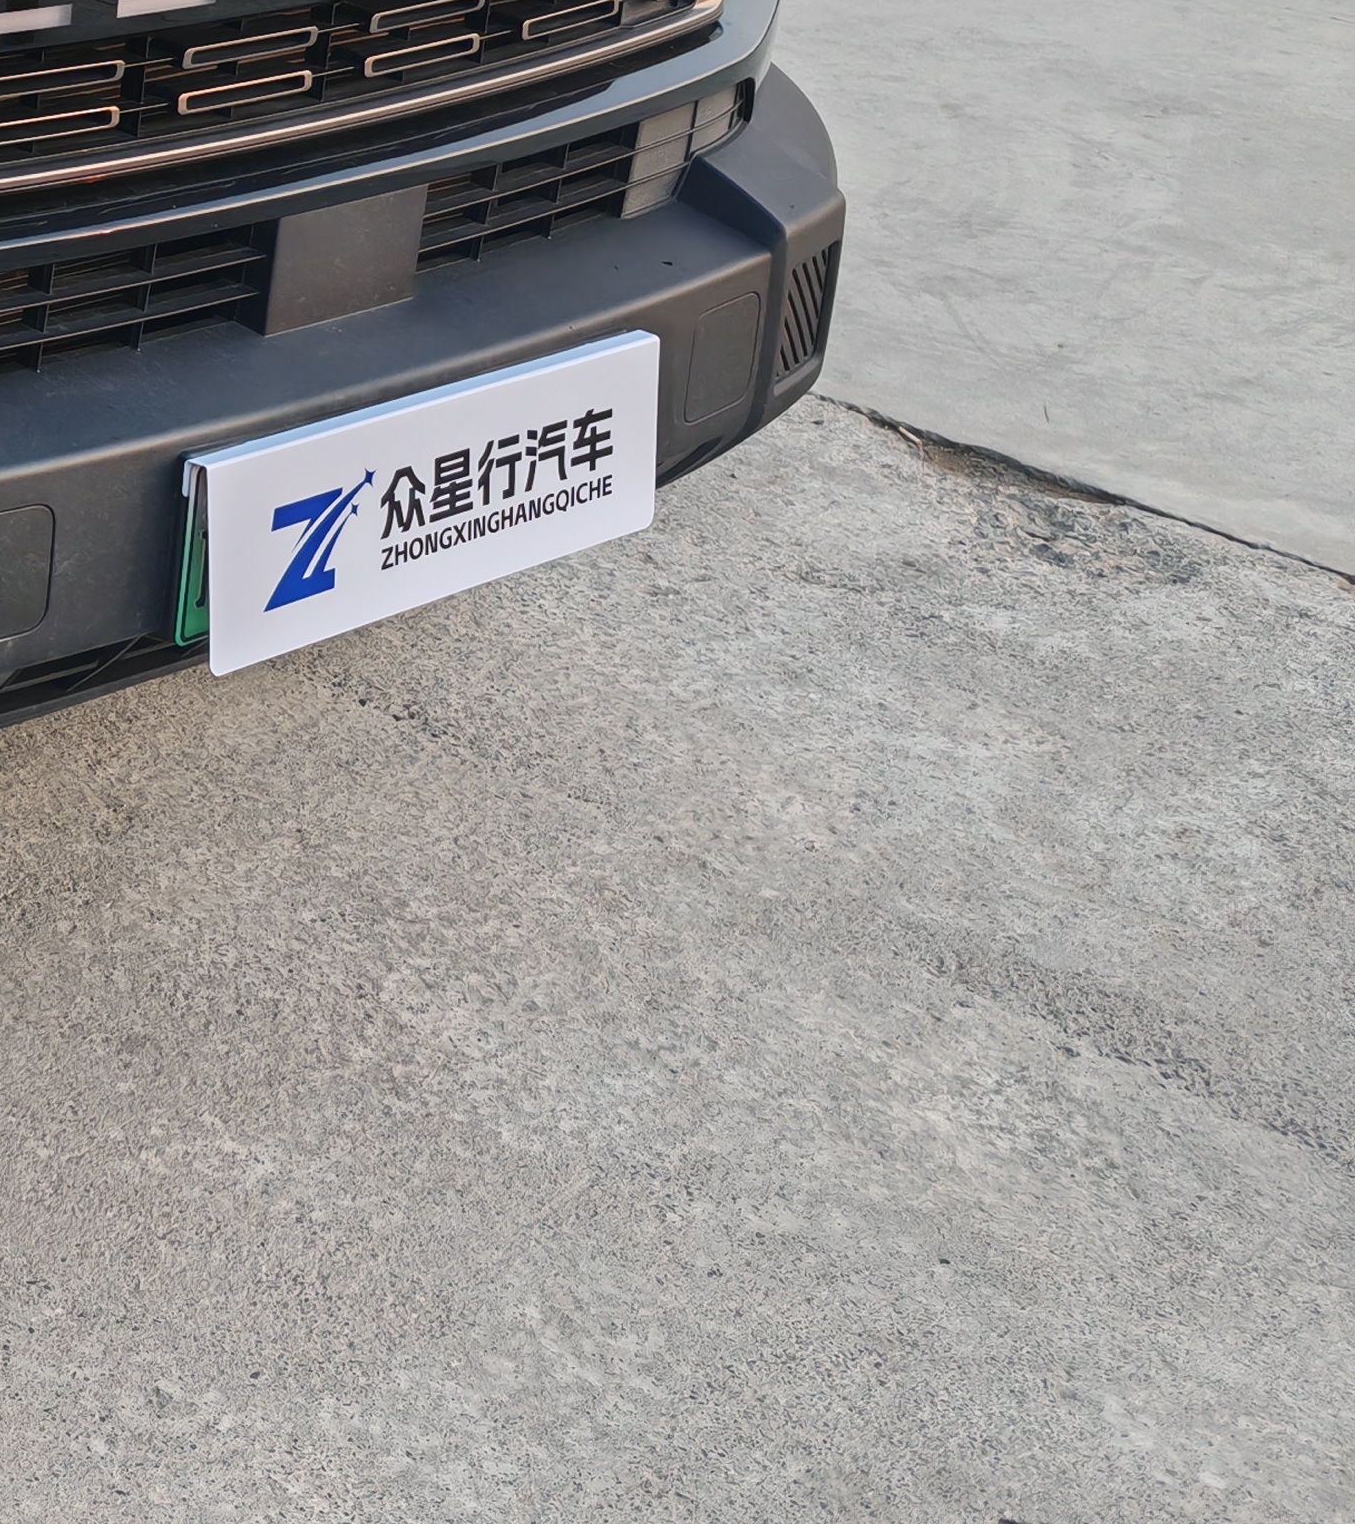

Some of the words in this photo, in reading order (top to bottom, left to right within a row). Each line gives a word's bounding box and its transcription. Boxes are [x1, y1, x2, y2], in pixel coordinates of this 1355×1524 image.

[380, 407, 614, 541] 众星行汽车
[380, 474, 614, 571] ZHONGXINGHANGQICHE
